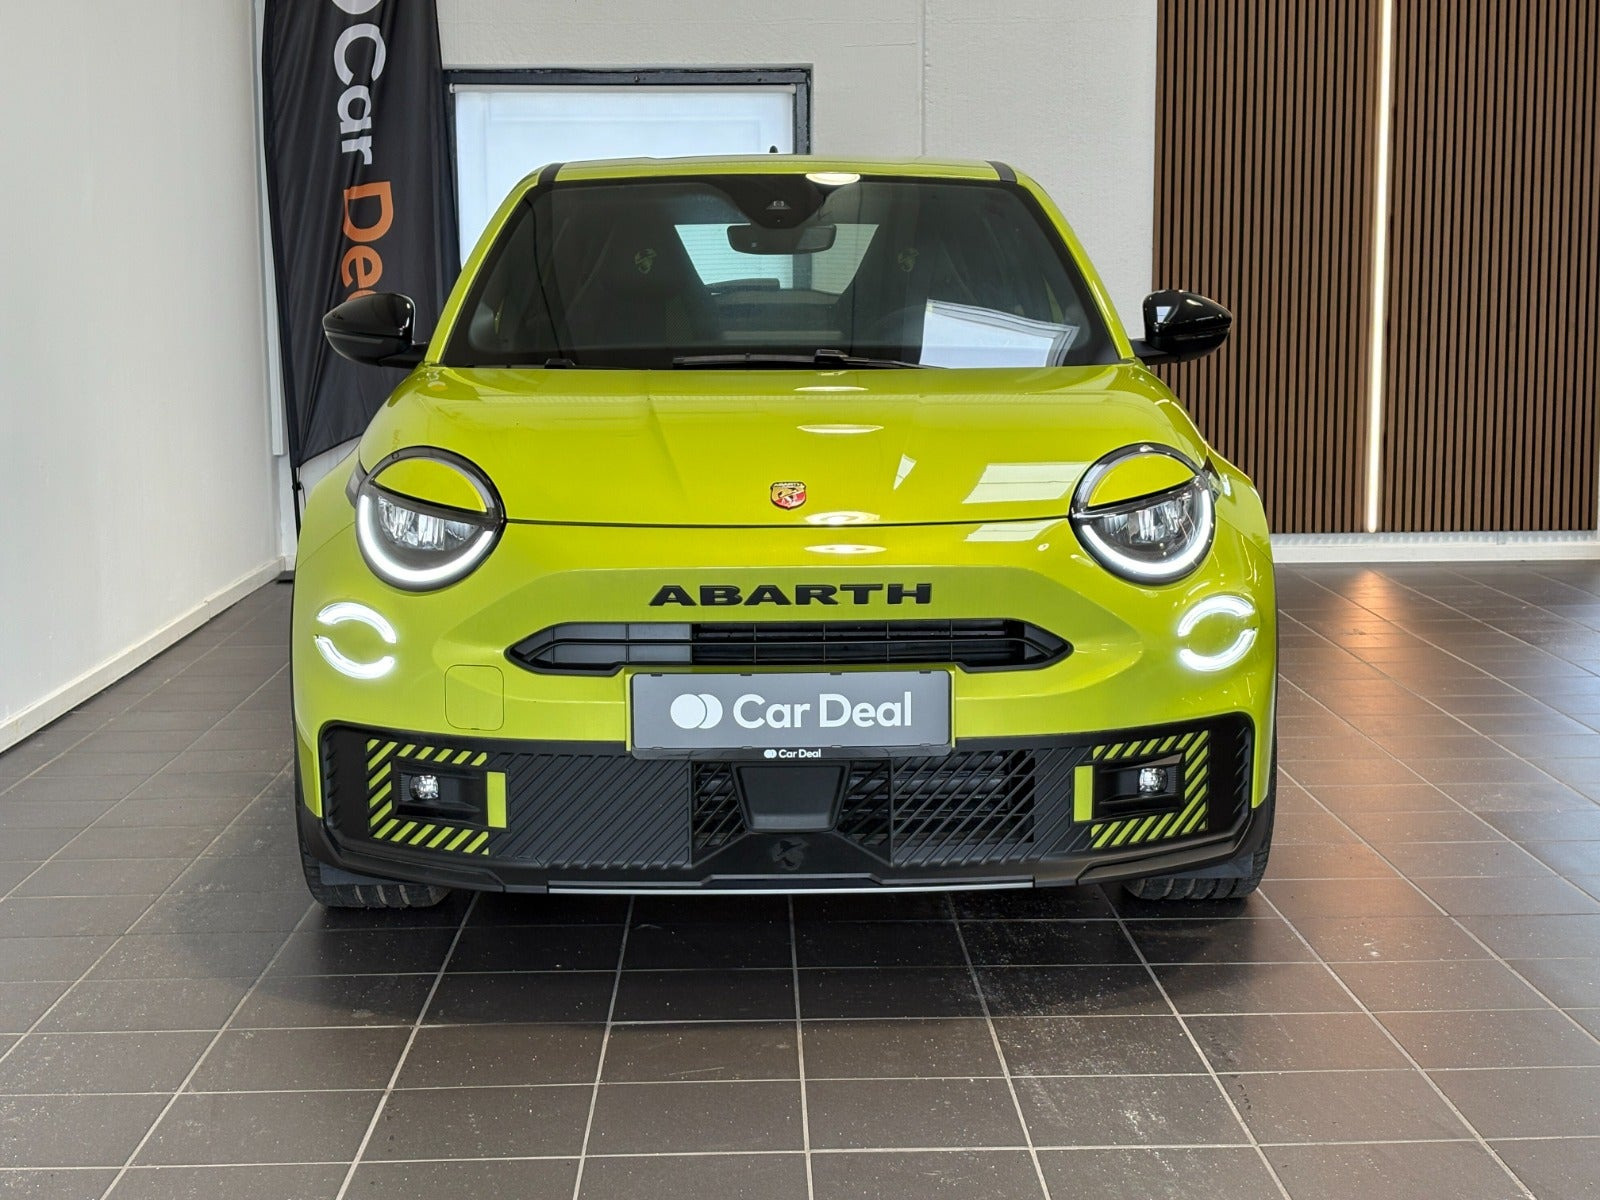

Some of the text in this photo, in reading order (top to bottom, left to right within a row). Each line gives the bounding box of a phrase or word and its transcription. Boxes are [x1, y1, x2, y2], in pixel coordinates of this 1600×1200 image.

[333, 23, 394, 301] Car De
[649, 583, 932, 606] ABARTH
[732, 691, 912, 729] Car Deal
[778, 748, 822, 759] Car Deal
